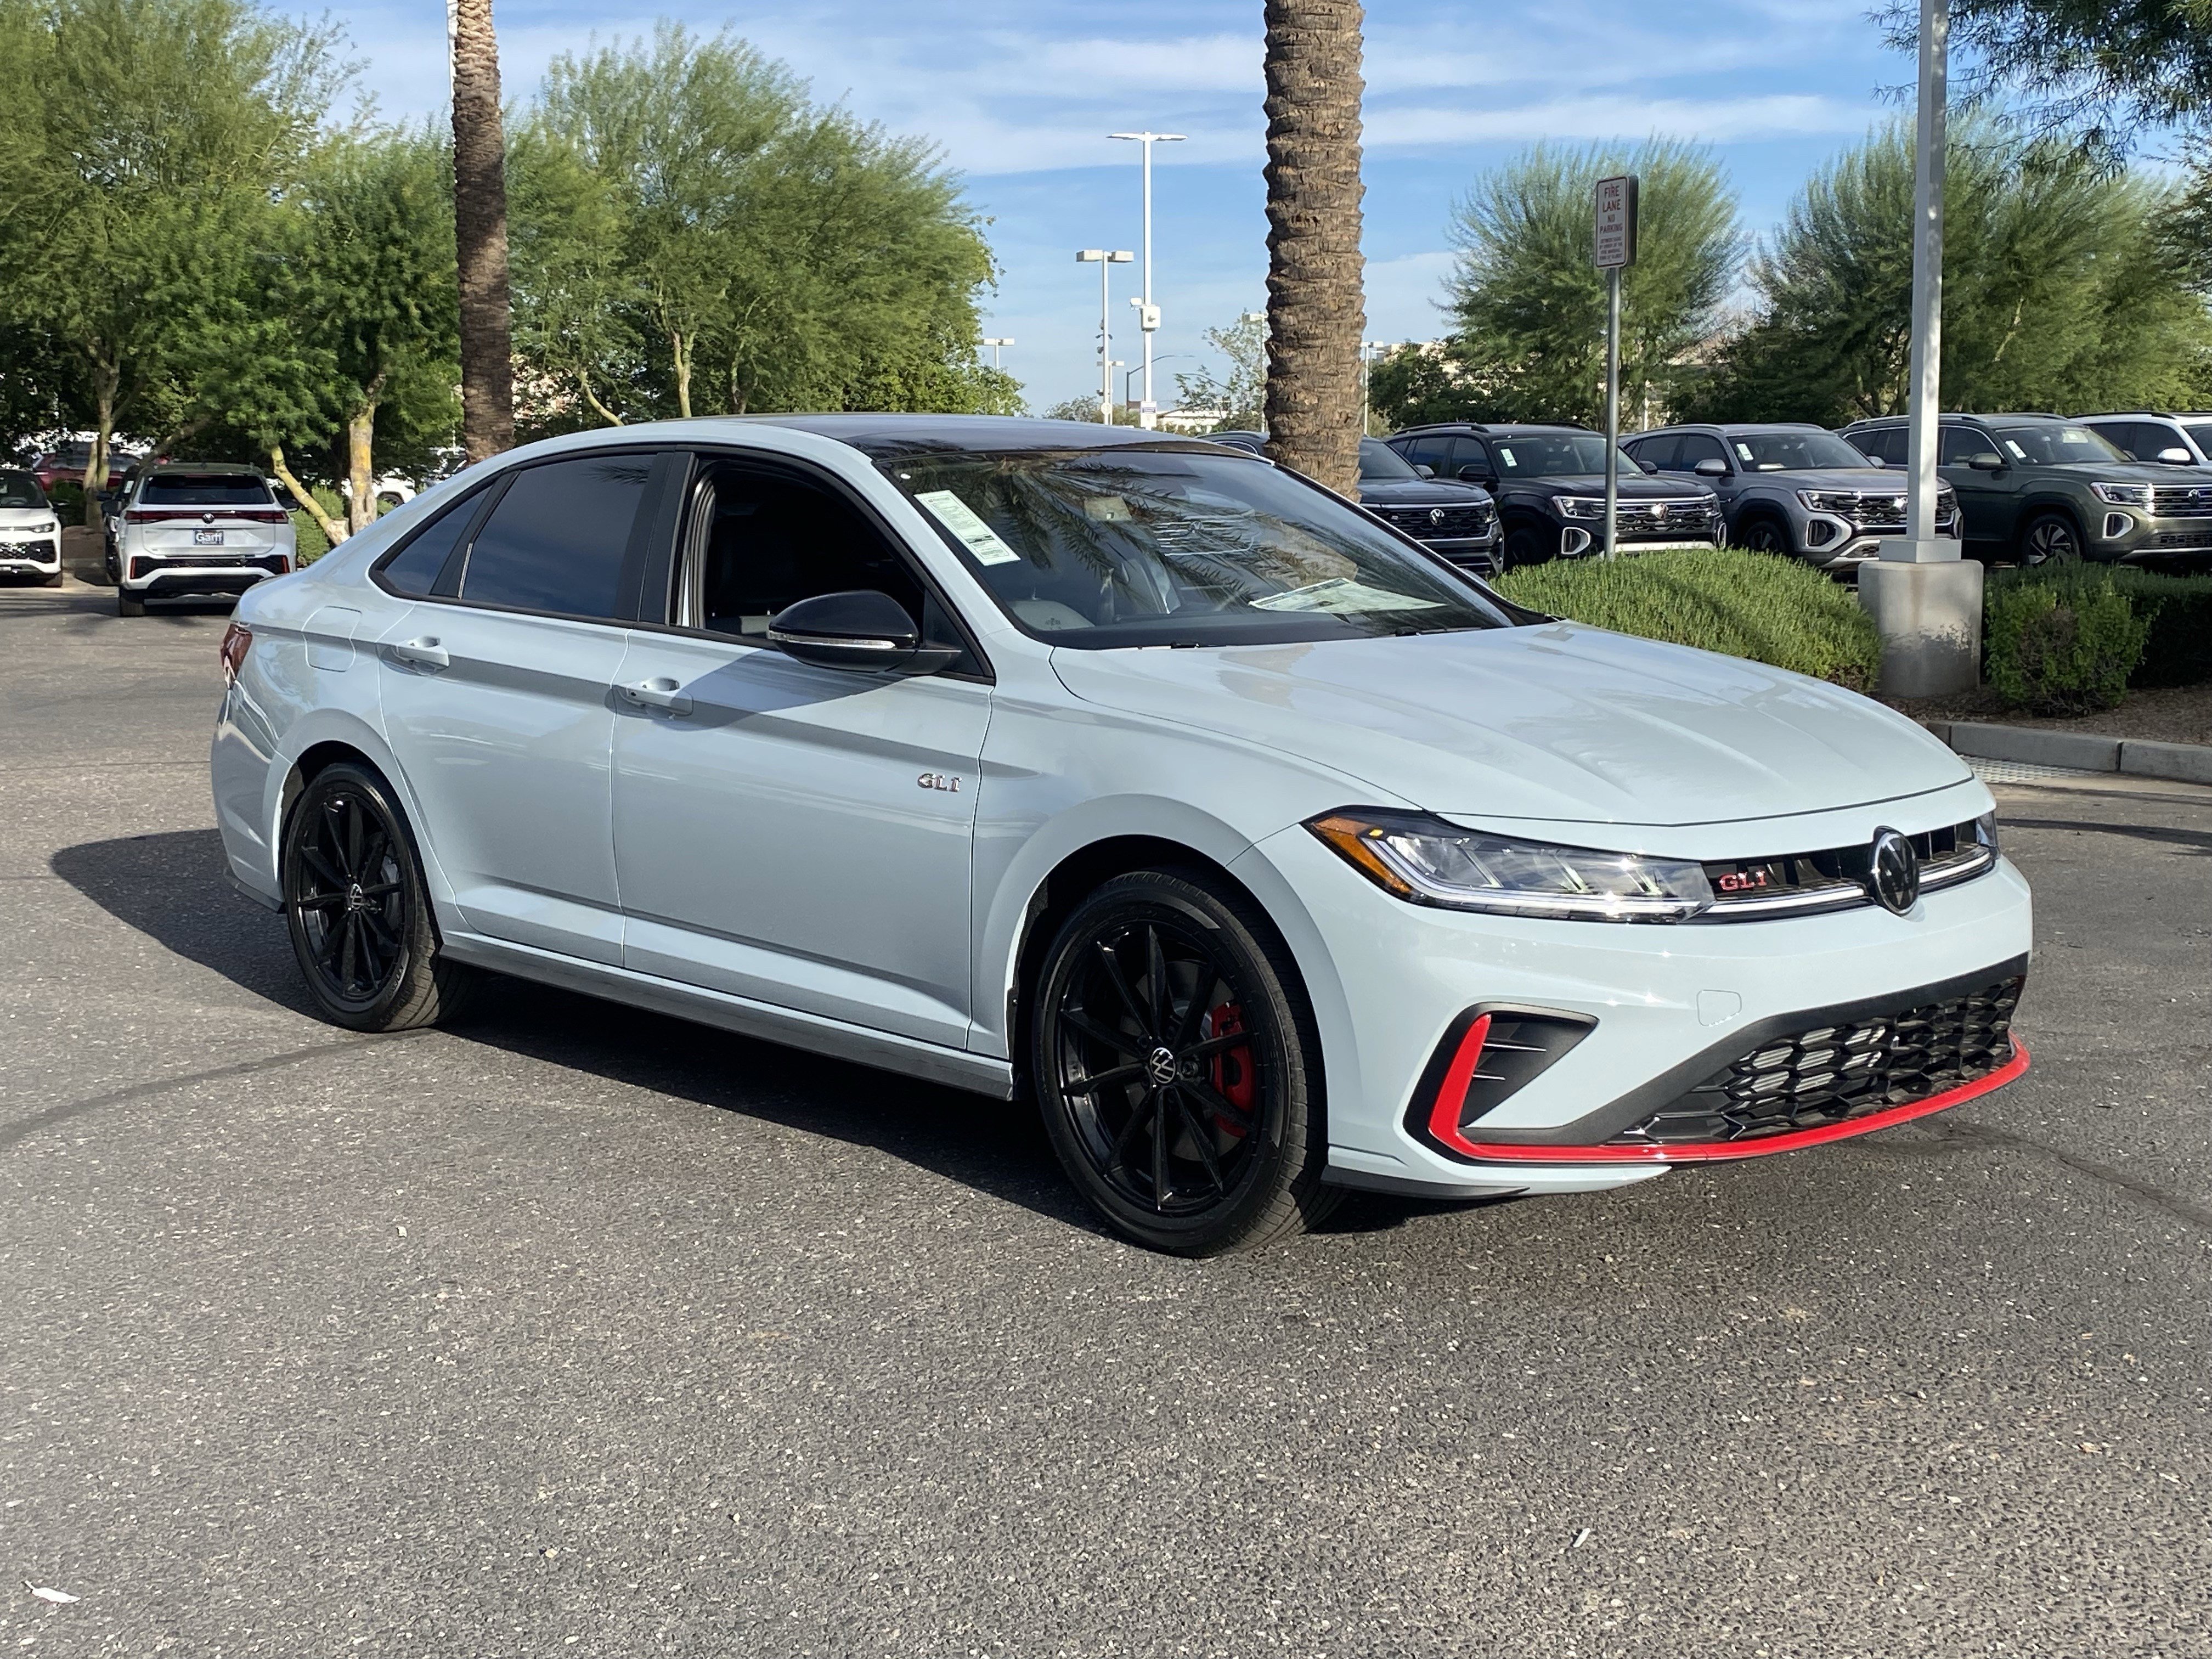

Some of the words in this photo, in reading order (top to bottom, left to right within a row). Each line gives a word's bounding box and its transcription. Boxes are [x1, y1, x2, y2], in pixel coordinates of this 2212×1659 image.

[1604, 185, 1620, 198] FIRE
[1602, 199, 1621, 213] LANE
[1607, 214, 1616, 223] NO
[1600, 223, 1623, 234] PARKING
[917, 773, 962, 793] GLI
[1719, 870, 1768, 891] GLI
